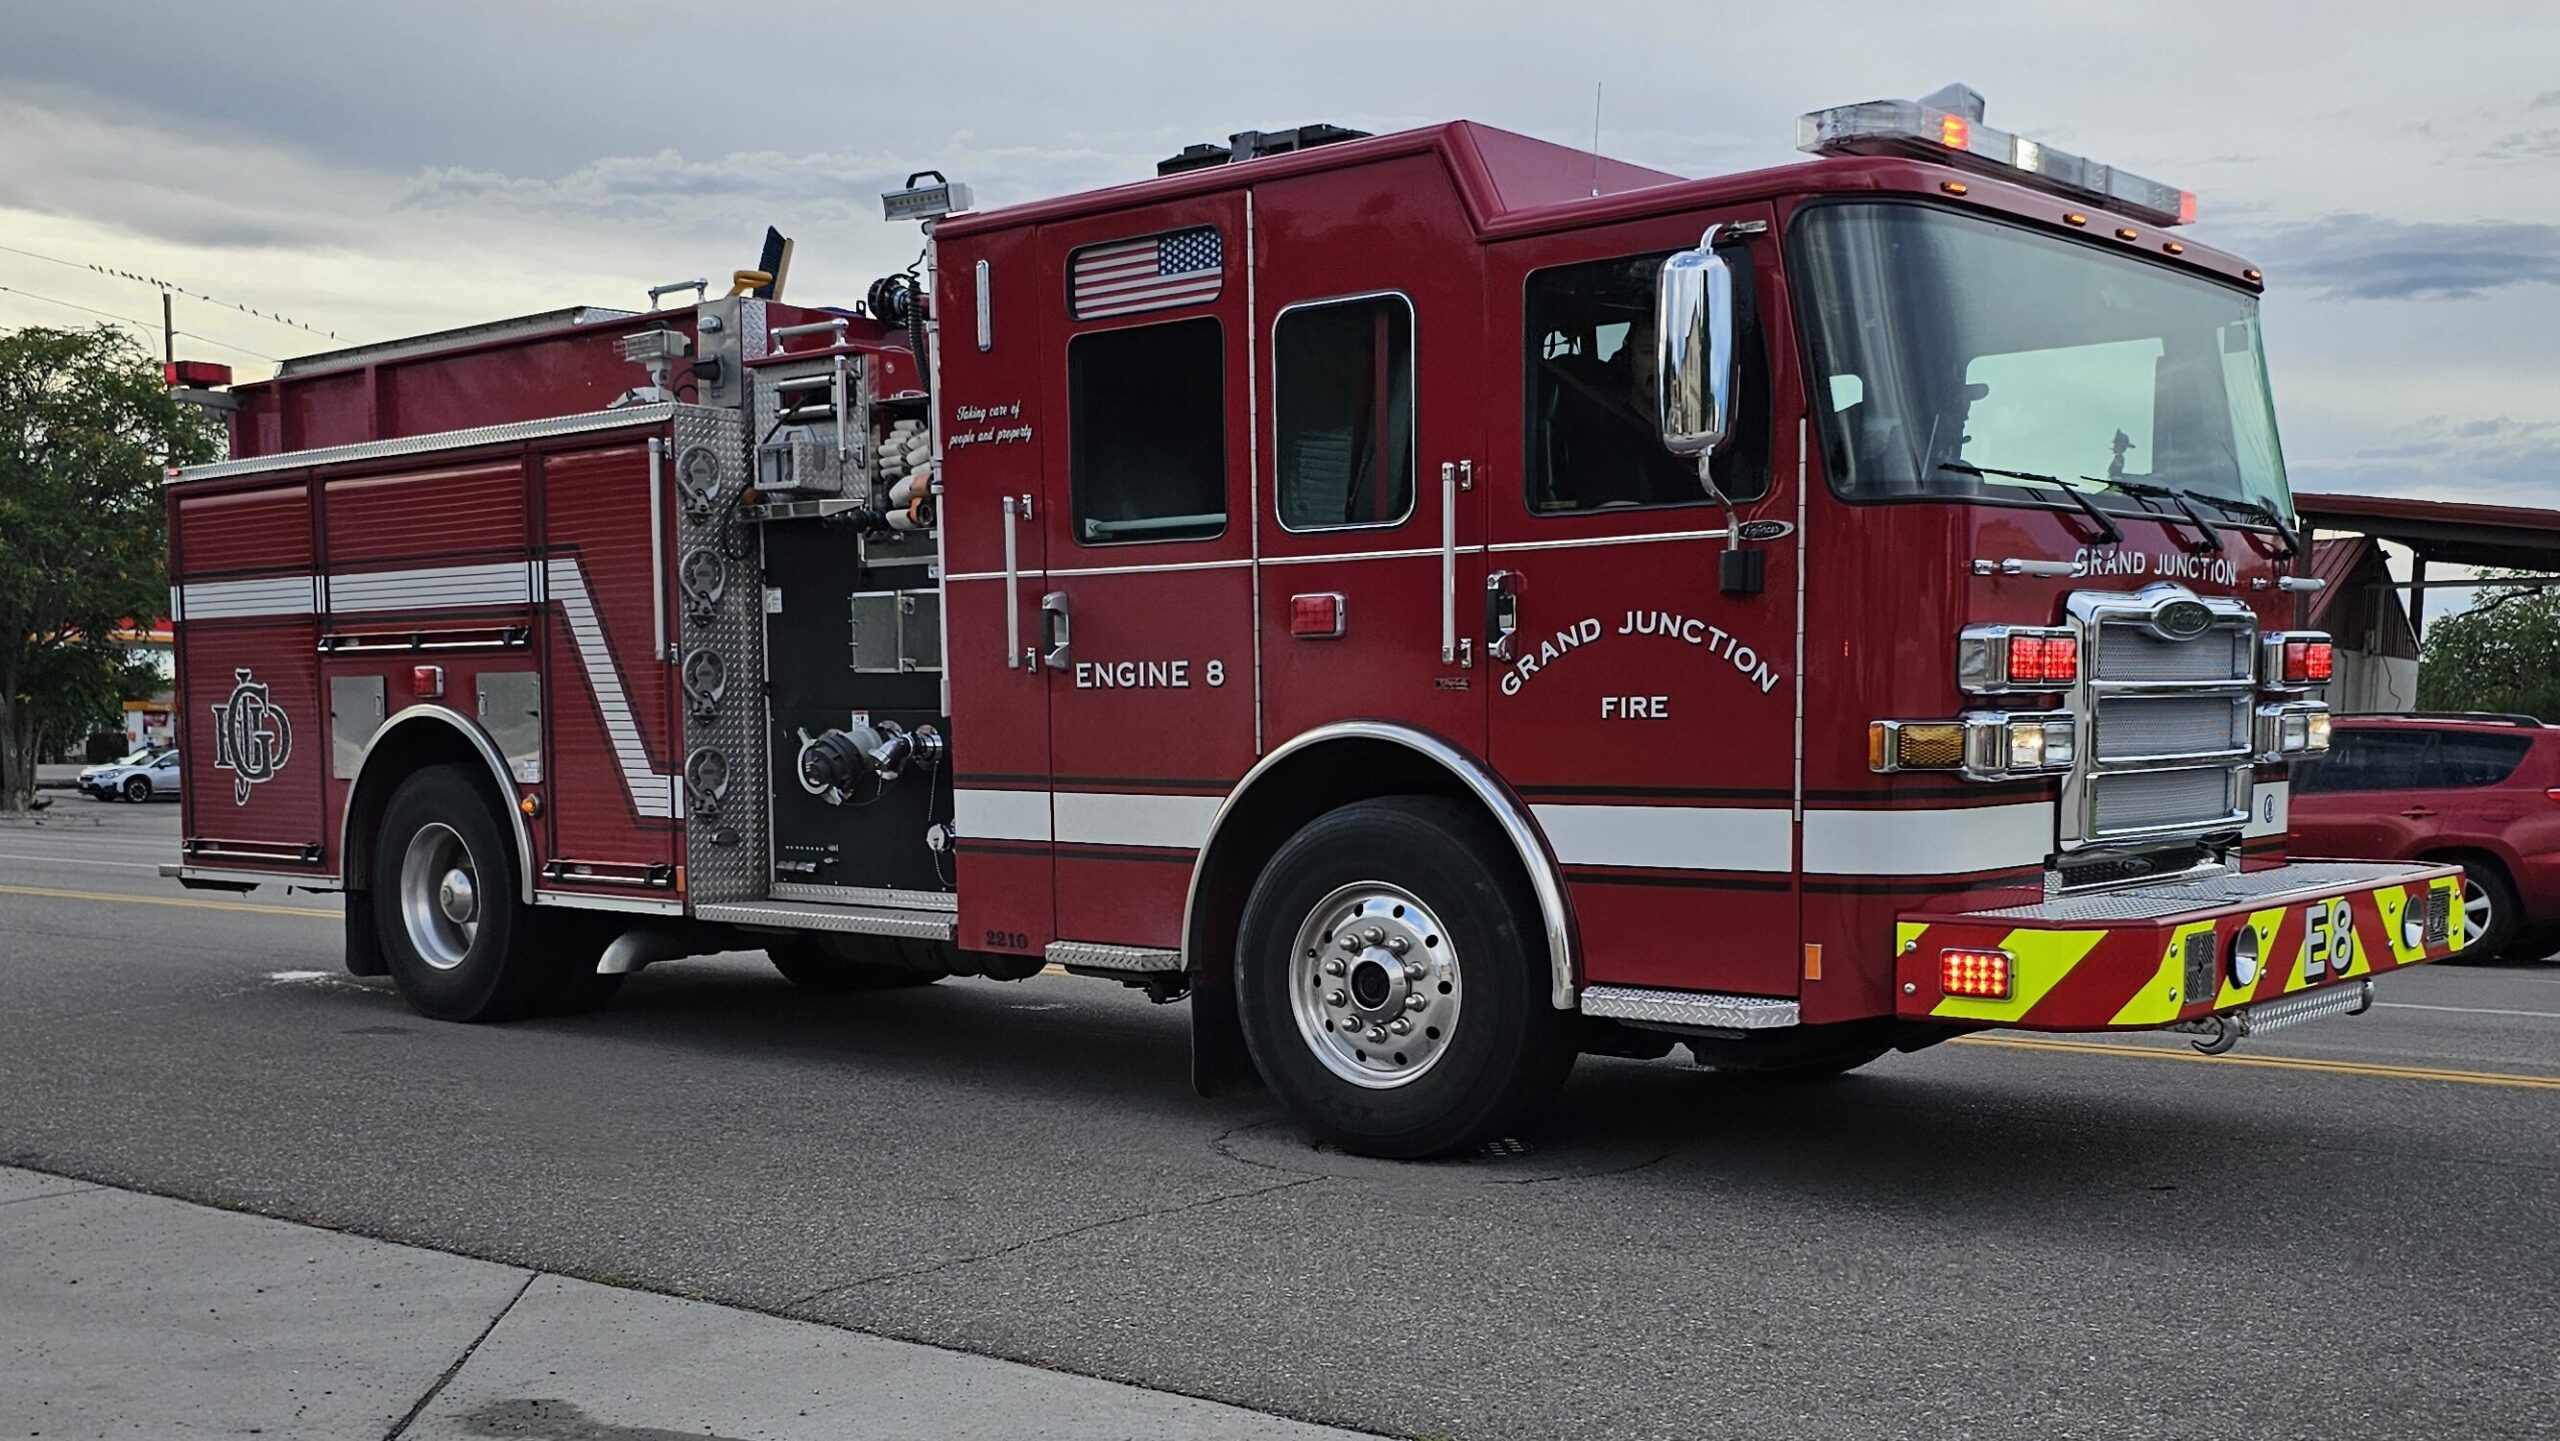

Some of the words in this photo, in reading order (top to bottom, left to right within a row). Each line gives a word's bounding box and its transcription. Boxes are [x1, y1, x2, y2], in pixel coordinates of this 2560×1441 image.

[956, 405, 987, 423] Taking
[989, 405, 1008, 417] care
[1010, 399, 1021, 419] of
[948, 429, 976, 450] people
[977, 426, 995, 442] and
[995, 423, 1033, 445] property
[2069, 547, 2147, 578] GRAND
[2153, 552, 2237, 587] JUNCTION
[1500, 617, 1602, 697] GRAND
[1617, 609, 1781, 694] JUNCTION
[1075, 660, 1191, 689] ENGINE
[1205, 658, 1226, 688] 8
[1601, 695, 1669, 720] FIRE
[985, 929, 1029, 950] 2210
[2303, 899, 2353, 984] E8
